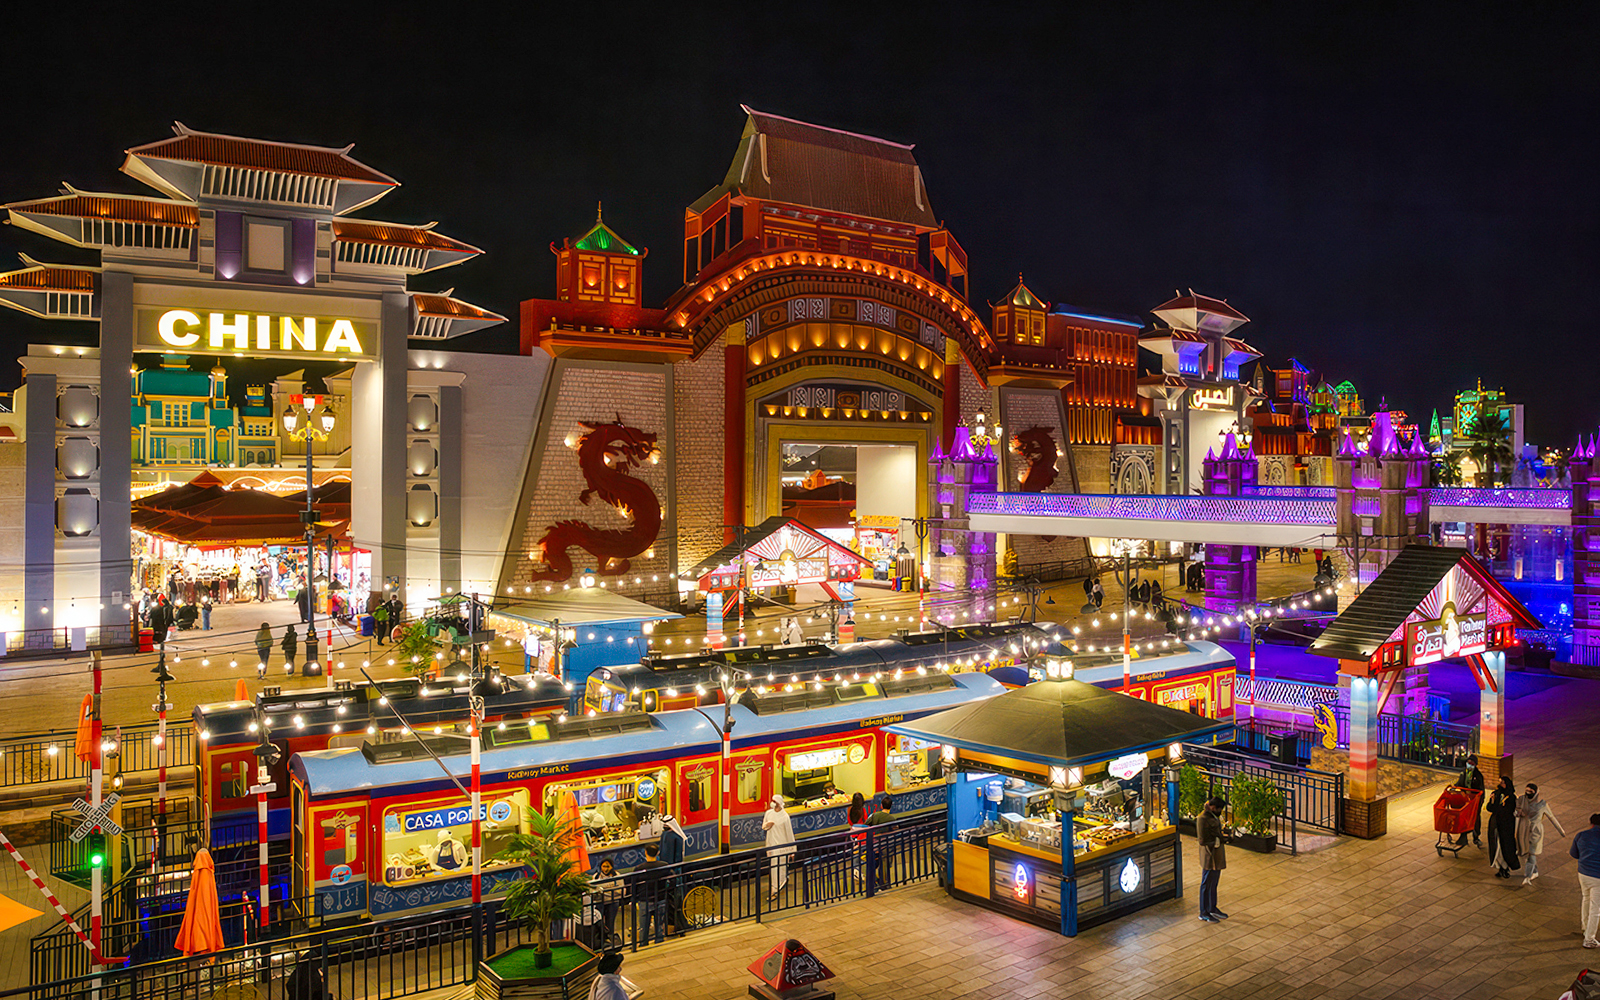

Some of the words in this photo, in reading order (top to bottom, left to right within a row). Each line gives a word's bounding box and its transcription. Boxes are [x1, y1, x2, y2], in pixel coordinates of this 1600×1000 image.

[157, 309, 363, 353] CHINA
[1192, 385, 1234, 409] الصين
[405, 813, 444, 830] CASA
